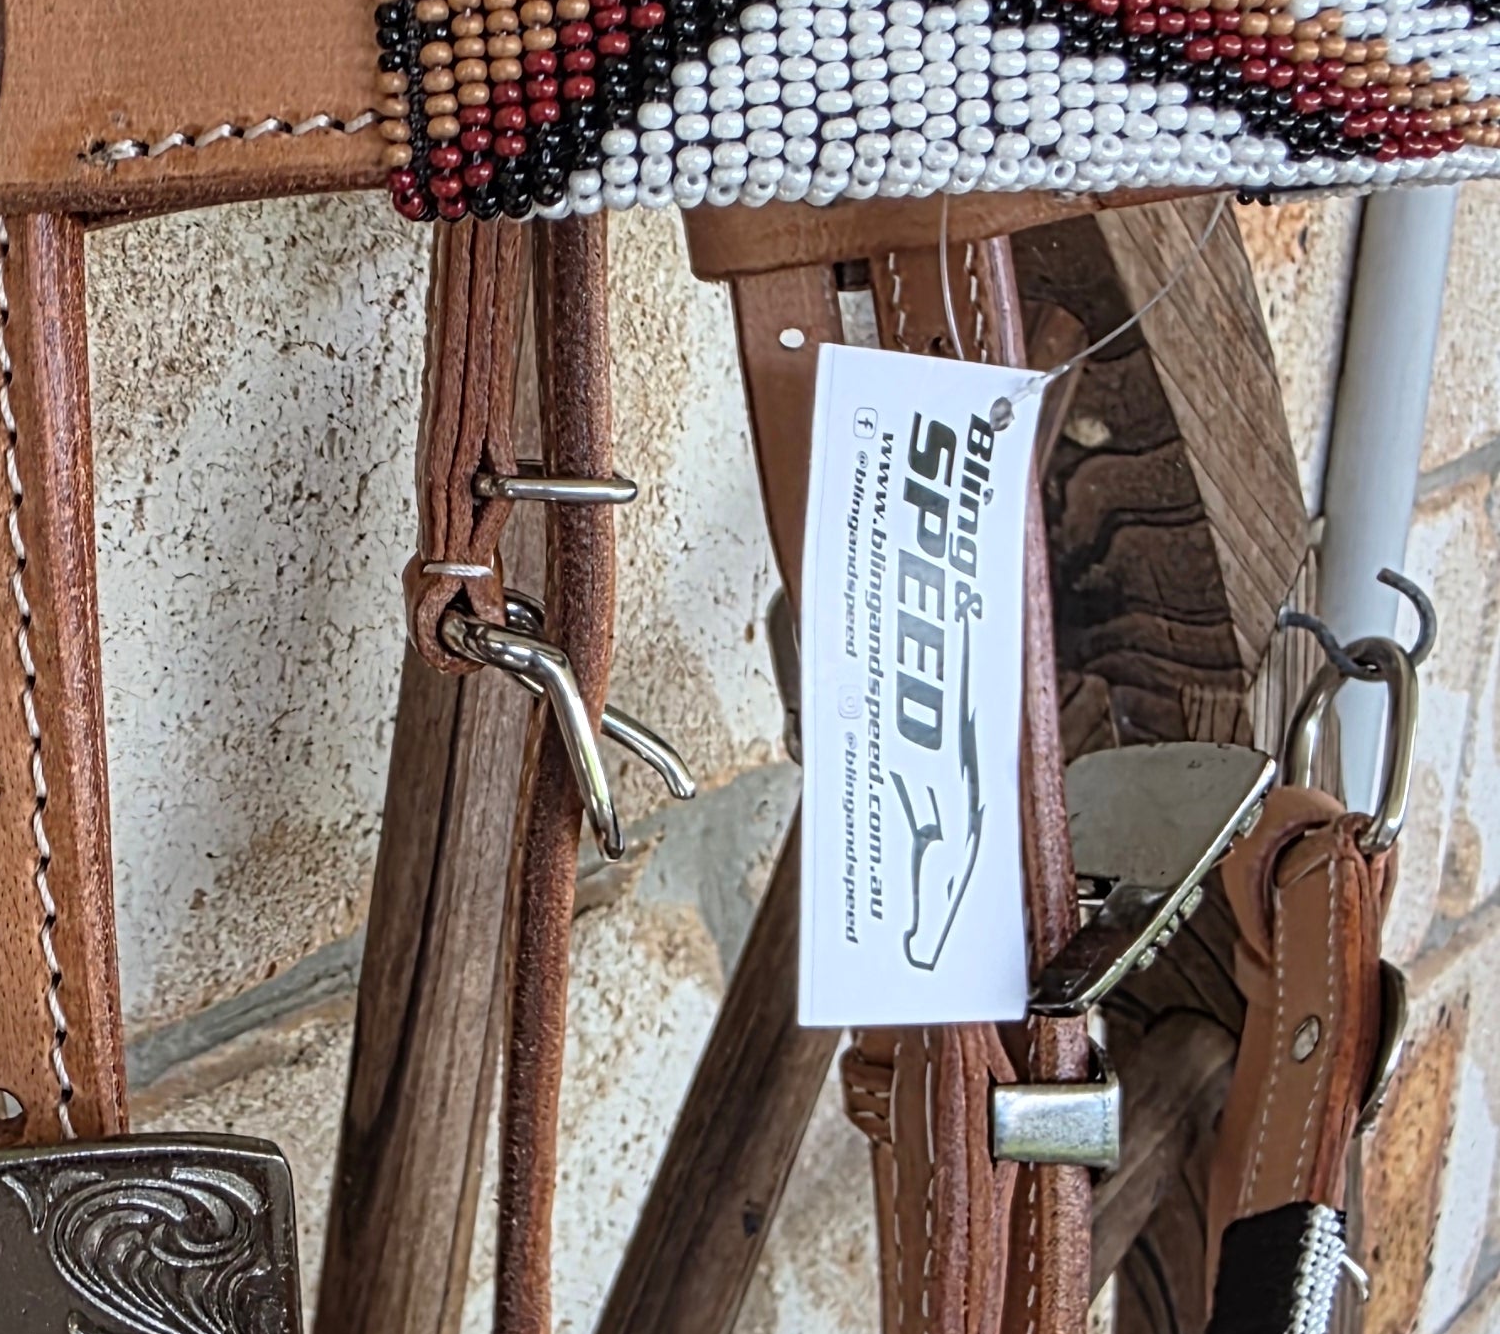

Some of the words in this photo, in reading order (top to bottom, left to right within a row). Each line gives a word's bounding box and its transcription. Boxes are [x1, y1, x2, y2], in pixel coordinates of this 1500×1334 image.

[845, 450, 869, 659] @blingandspeed
[864, 432, 894, 920] www.blingandspeed.com.au
[896, 411, 957, 751] SPEED
